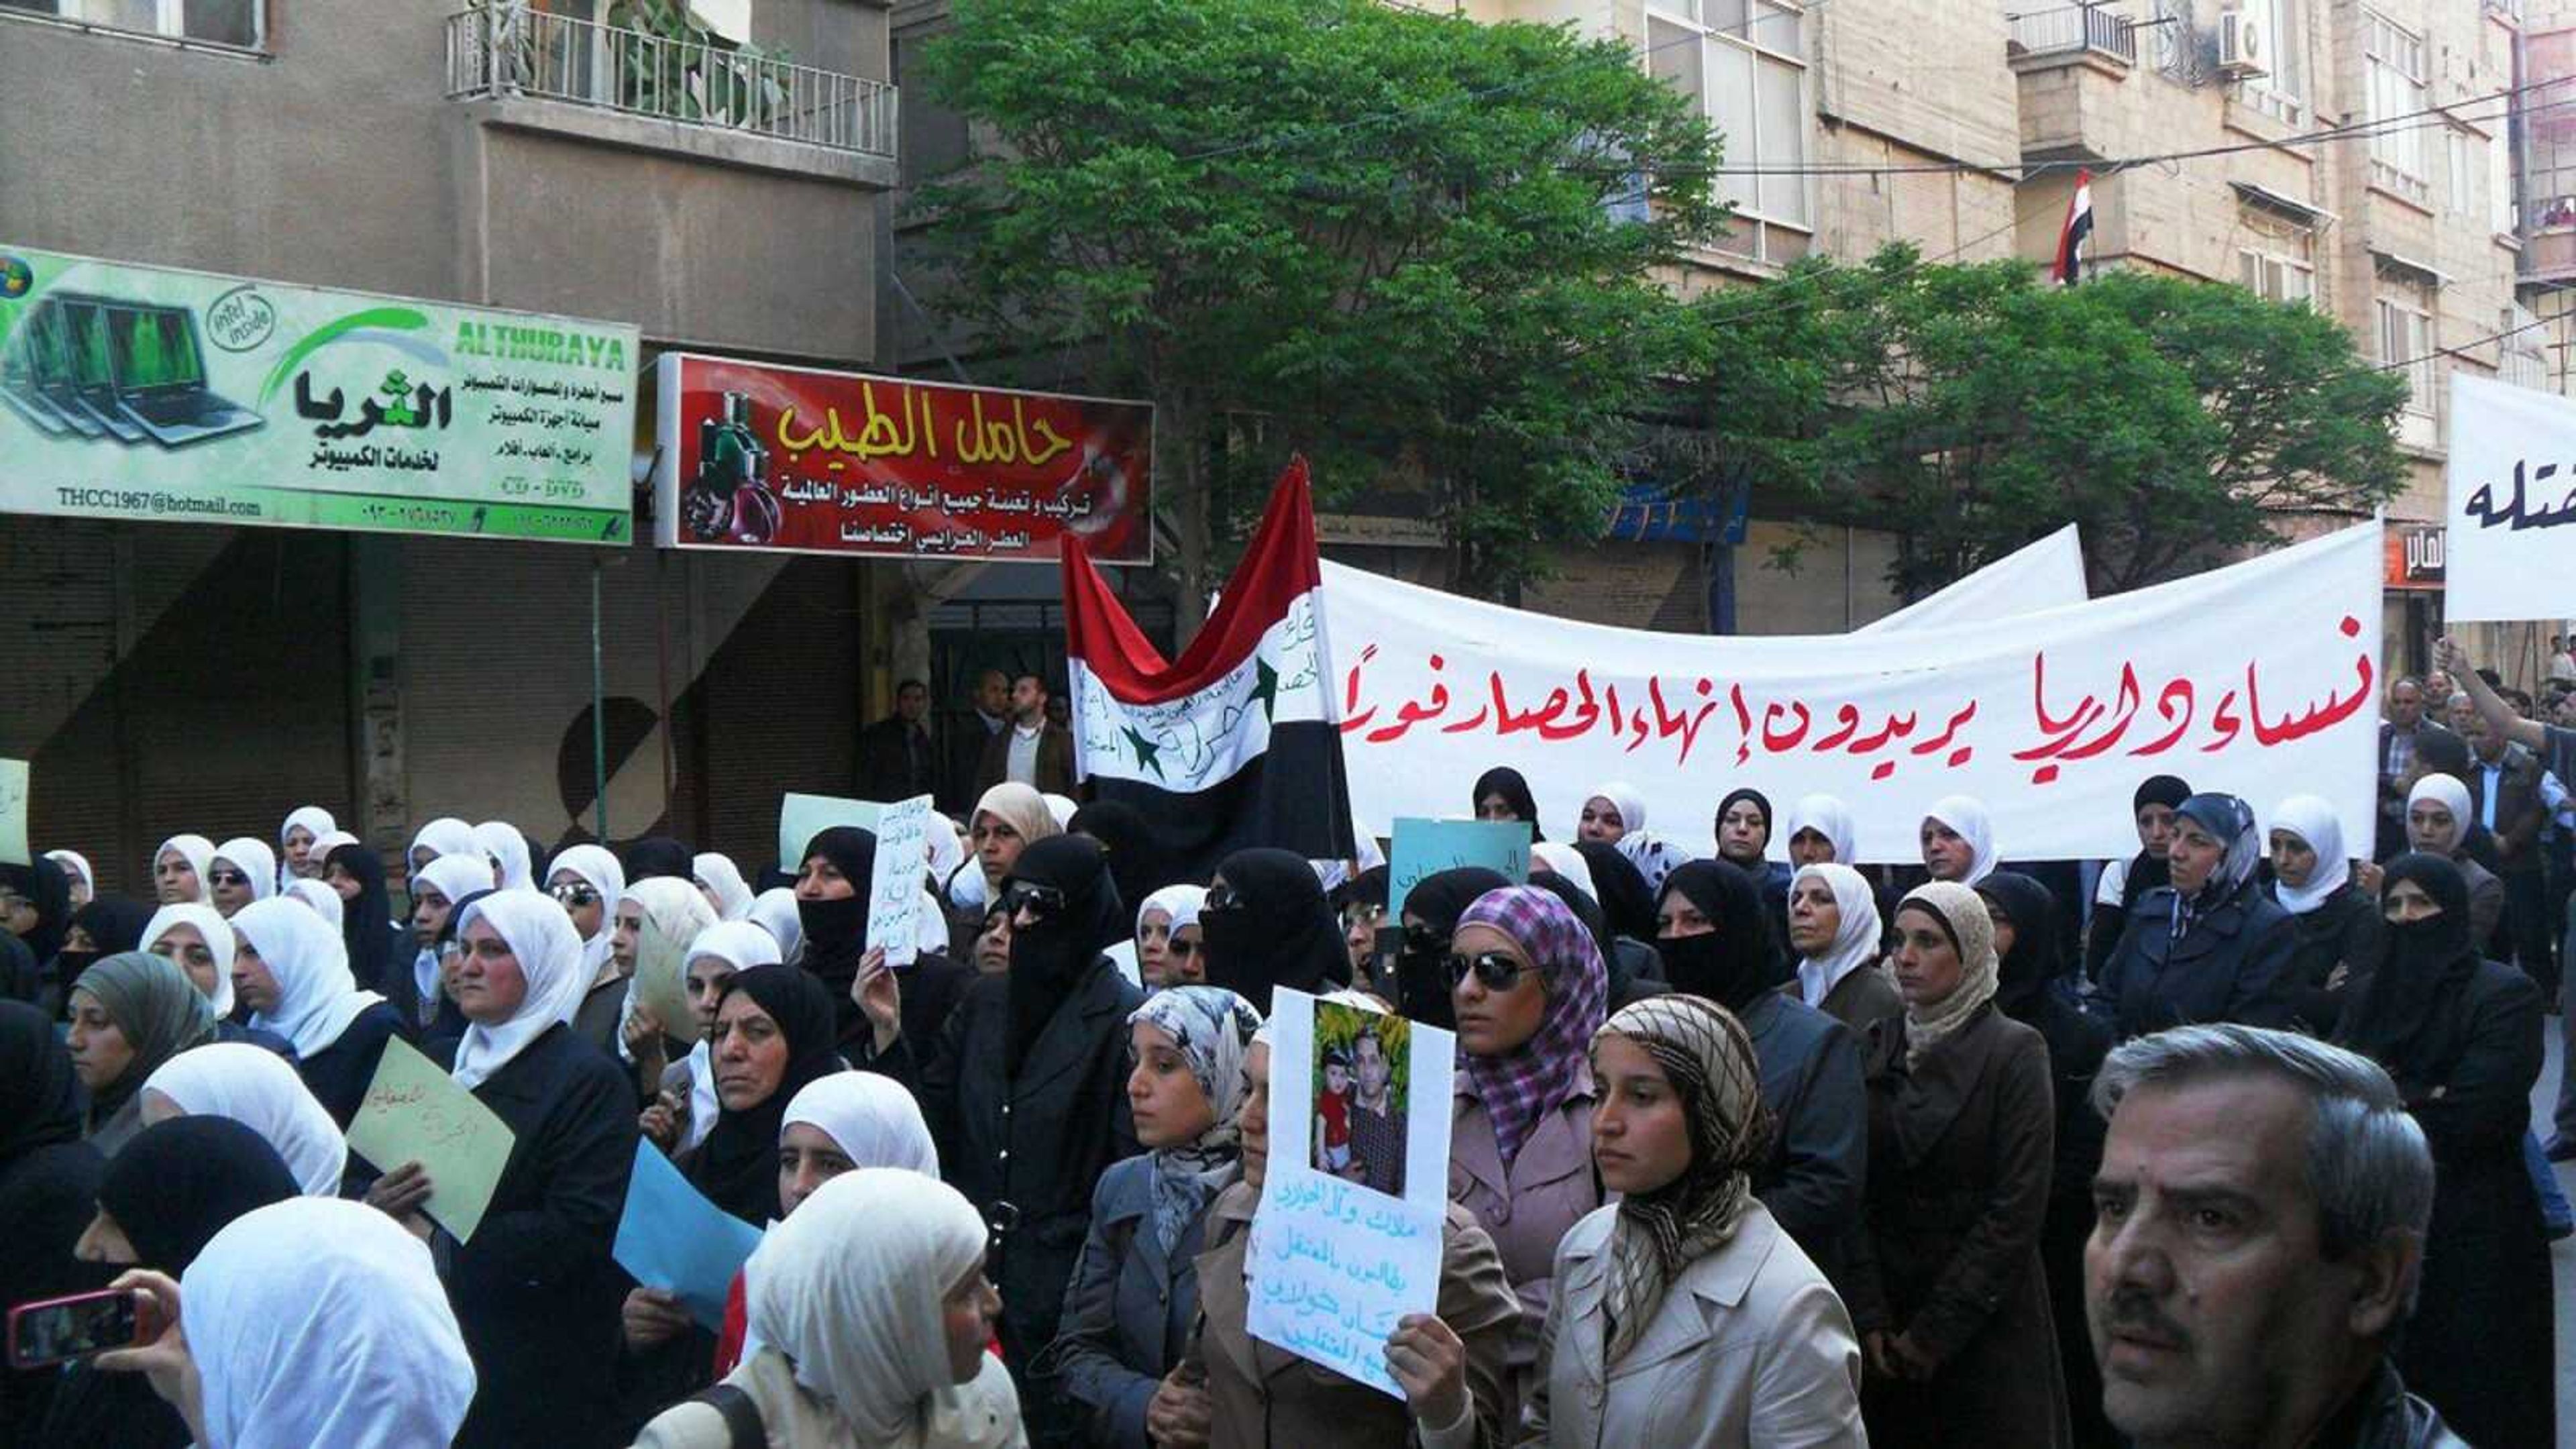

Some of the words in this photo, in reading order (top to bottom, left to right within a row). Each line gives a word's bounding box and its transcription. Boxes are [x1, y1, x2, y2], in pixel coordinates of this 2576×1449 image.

[454, 321, 625, 372] ALTHURAYA
[295, 369, 452, 439] الثريا
[487, 404, 538, 426] الكمبيوتر
[777, 380, 937, 470] الطيب
[957, 392, 1073, 465] حامل
[308, 441, 382, 472] الكمبيوتر
[383, 447, 439, 471] لخدمات
[56, 486, 262, 517] THCC1967@hotmail.com
[781, 474, 838, 506] العالمية
[942, 492, 982, 516] جميع
[1043, 493, 1091, 519] تركيب
[841, 520, 912, 543] اختصاصنا
[986, 529, 1030, 551] العطر
[1440, 667, 1623, 741] الحصار
[2200, 614, 2373, 753] نساء
[1624, 674, 1752, 766] إنهاء
[2010, 649, 2194, 784] داريا
[1762, 698, 1978, 781] يريدون
